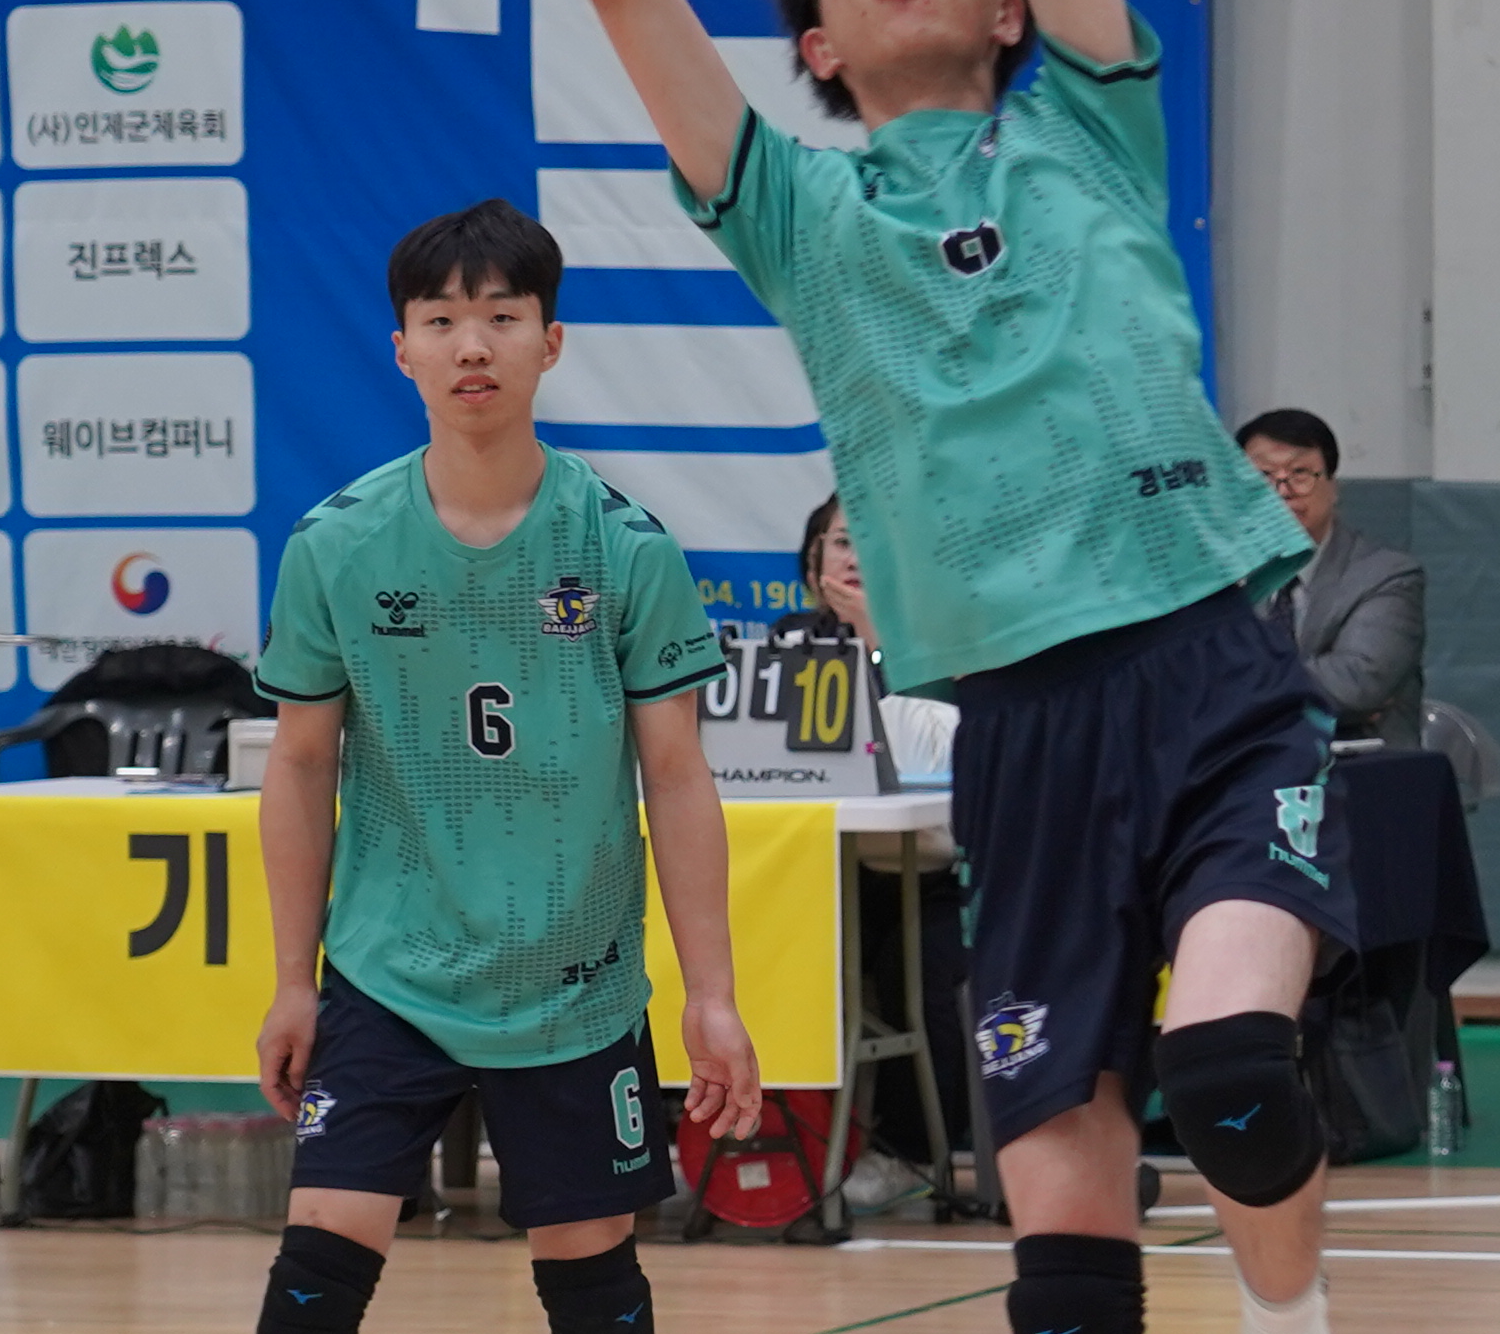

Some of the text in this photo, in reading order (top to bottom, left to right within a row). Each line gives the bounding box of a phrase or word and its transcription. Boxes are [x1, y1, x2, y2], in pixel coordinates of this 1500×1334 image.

[28, 109, 227, 146] (사)인제군체육회
[68, 240, 198, 281] 진프렉스
[41, 417, 234, 461] 웨이브컴퍼니
[371, 622, 426, 638] hummel
[465, 681, 515, 759] 6
[794, 658, 850, 745] 10
[711, 768, 831, 784] HAMPION.
[610, 1066, 645, 1150] 6
